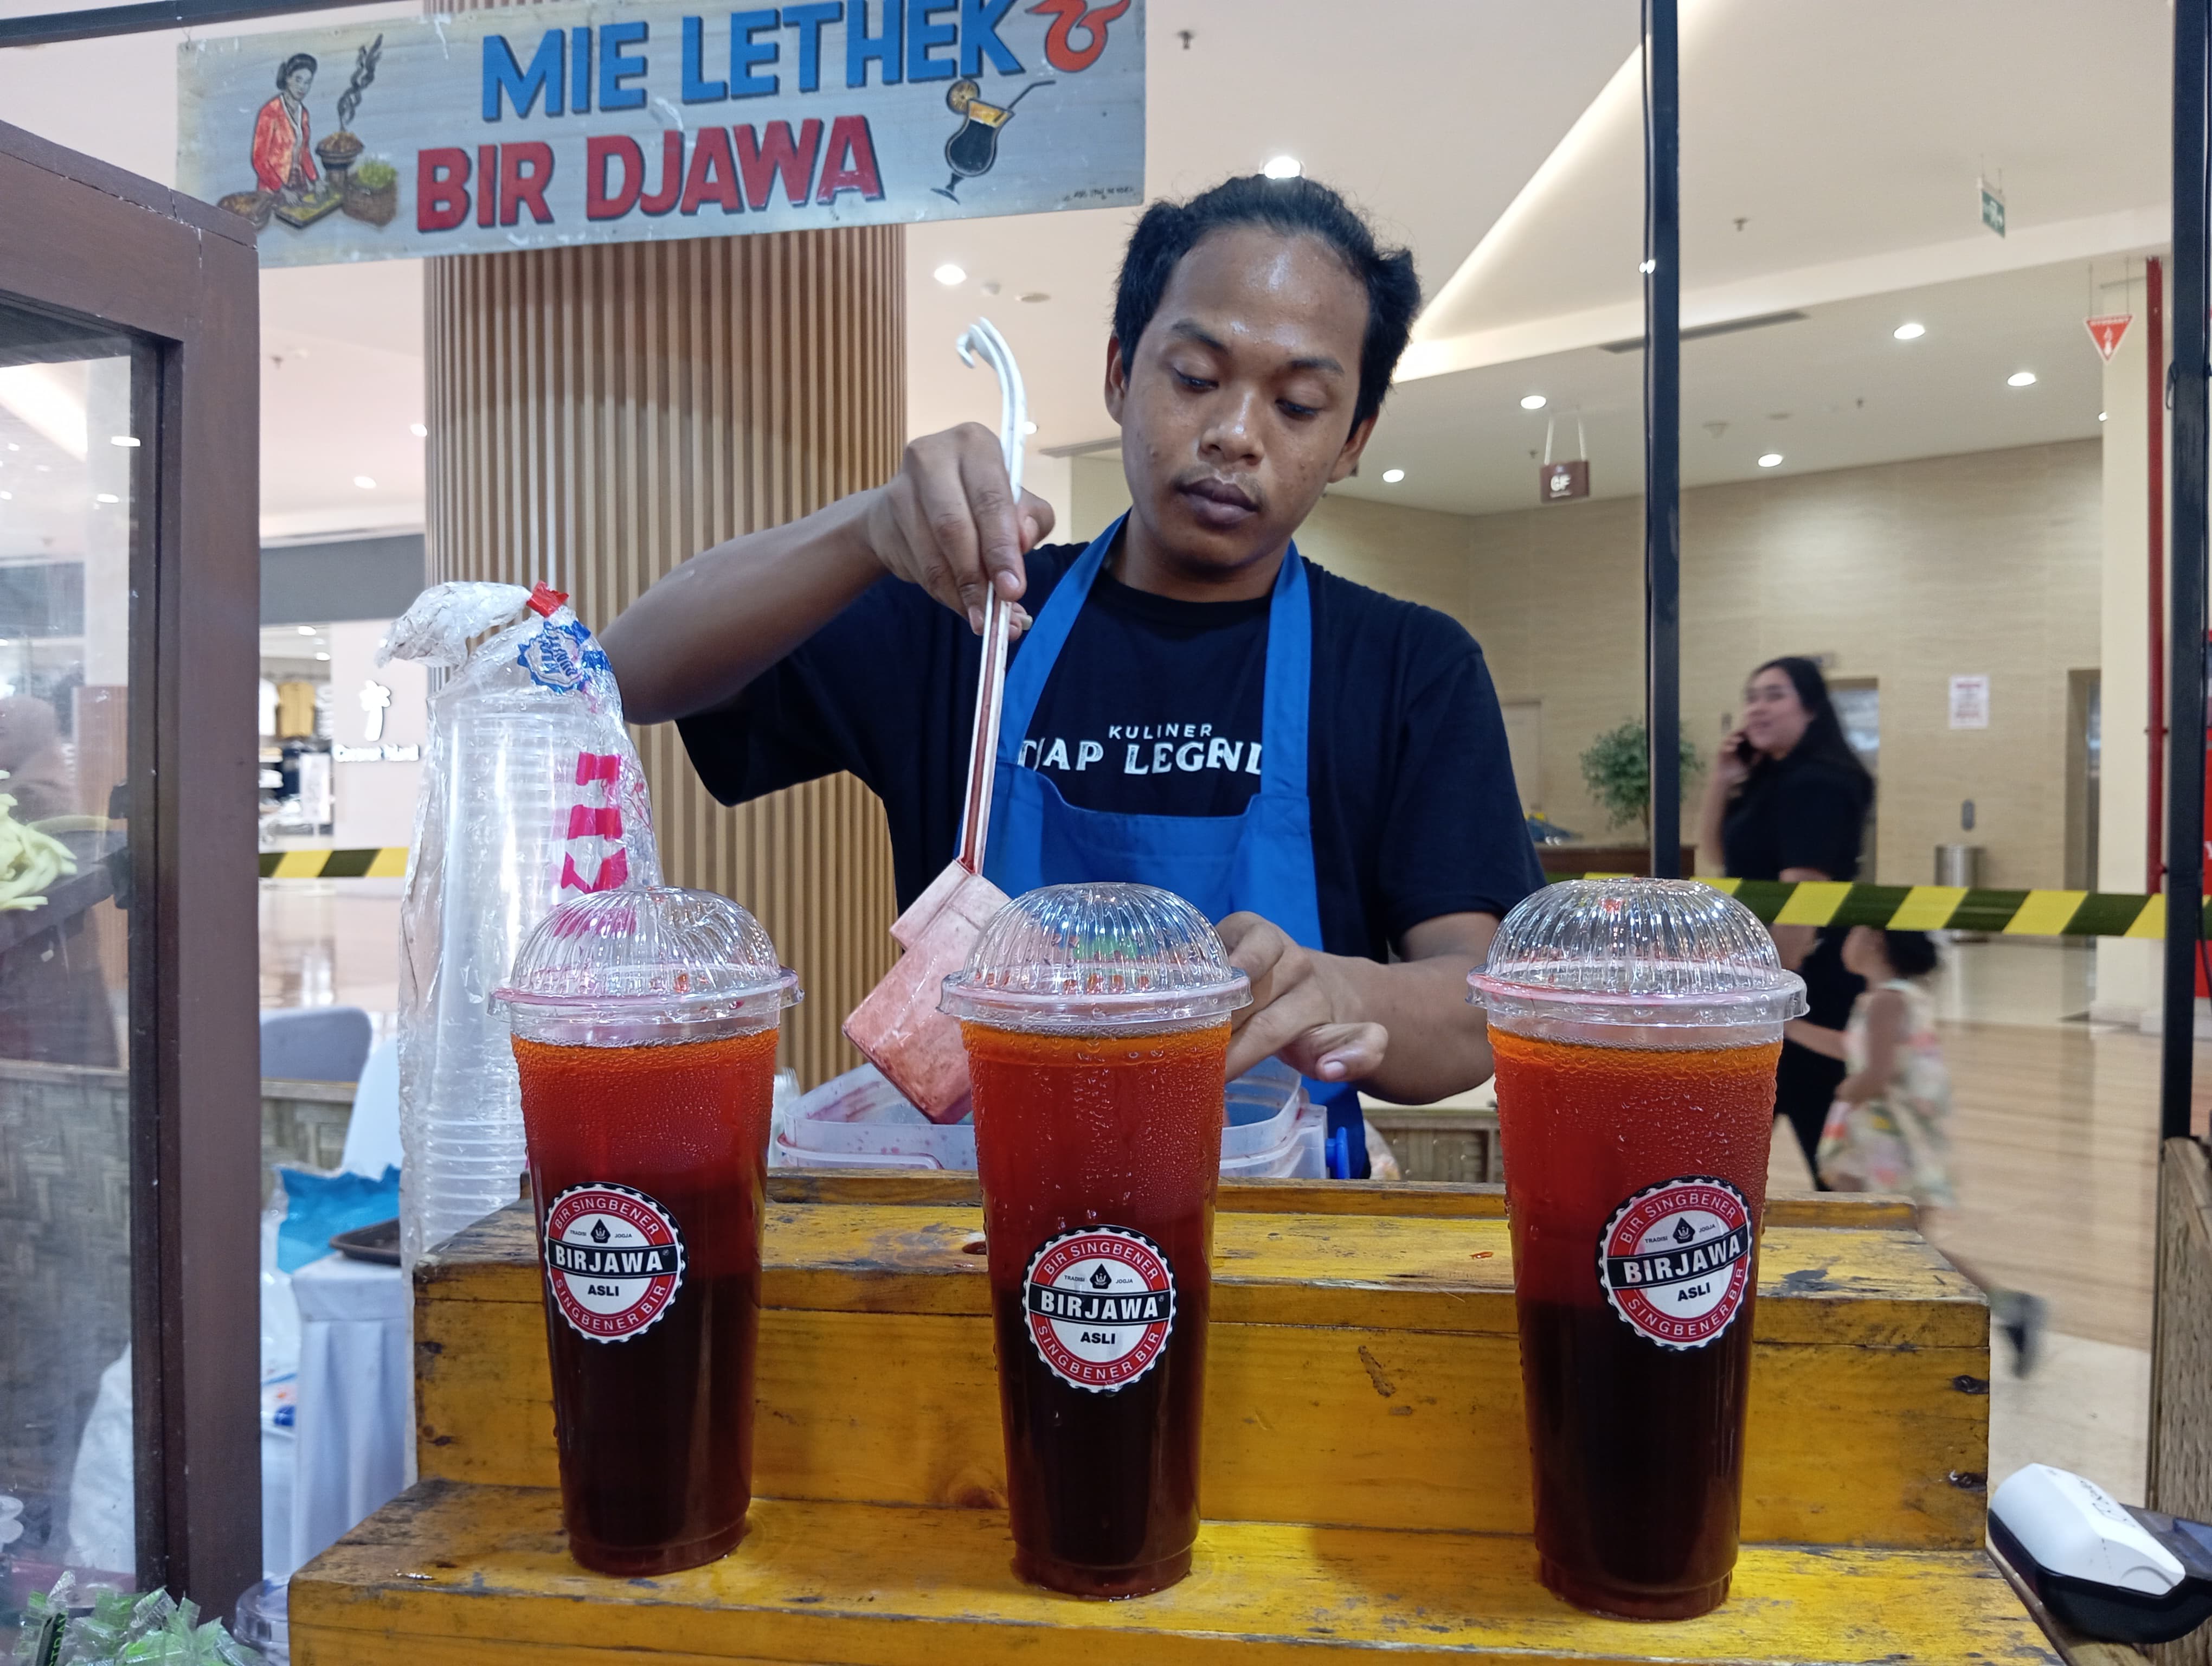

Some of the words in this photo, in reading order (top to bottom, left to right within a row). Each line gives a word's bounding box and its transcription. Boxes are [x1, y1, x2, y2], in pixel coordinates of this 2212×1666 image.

[482, 21, 648, 122] MIE
[681, 0, 1026, 105] LETHEK
[417, 141, 555, 233] BIR
[586, 114, 885, 221] DJAWA
[1109, 723, 1213, 740] KULINER
[555, 1207, 571, 1229] BIR
[572, 1197, 659, 1235] SINGBENER
[1620, 1217, 1644, 1244] BIR
[1645, 1193, 1736, 1219] SINGBENER
[1644, 1235, 1668, 1244] TRADISI
[555, 1245, 663, 1273] BIRJAWA
[1044, 1252, 1068, 1276] BIR
[1070, 1242, 1159, 1280] SINGBENER
[1623, 1234, 1741, 1284] BIRJAWA
[556, 1278, 639, 1330] SINGBENER
[641, 1285, 666, 1315] BIR
[588, 1285, 619, 1297] ASLI
[1040, 1290, 1158, 1320] BIRJAWA
[1628, 1298, 1729, 1336] SINGBENER
[1728, 1267, 1744, 1301] BIR
[1677, 1282, 1711, 1302] ASLI
[1038, 1325, 1133, 1379] SINGBENER
[1135, 1332, 1159, 1362] BIR
[1080, 1331, 1116, 1344] ASLI
